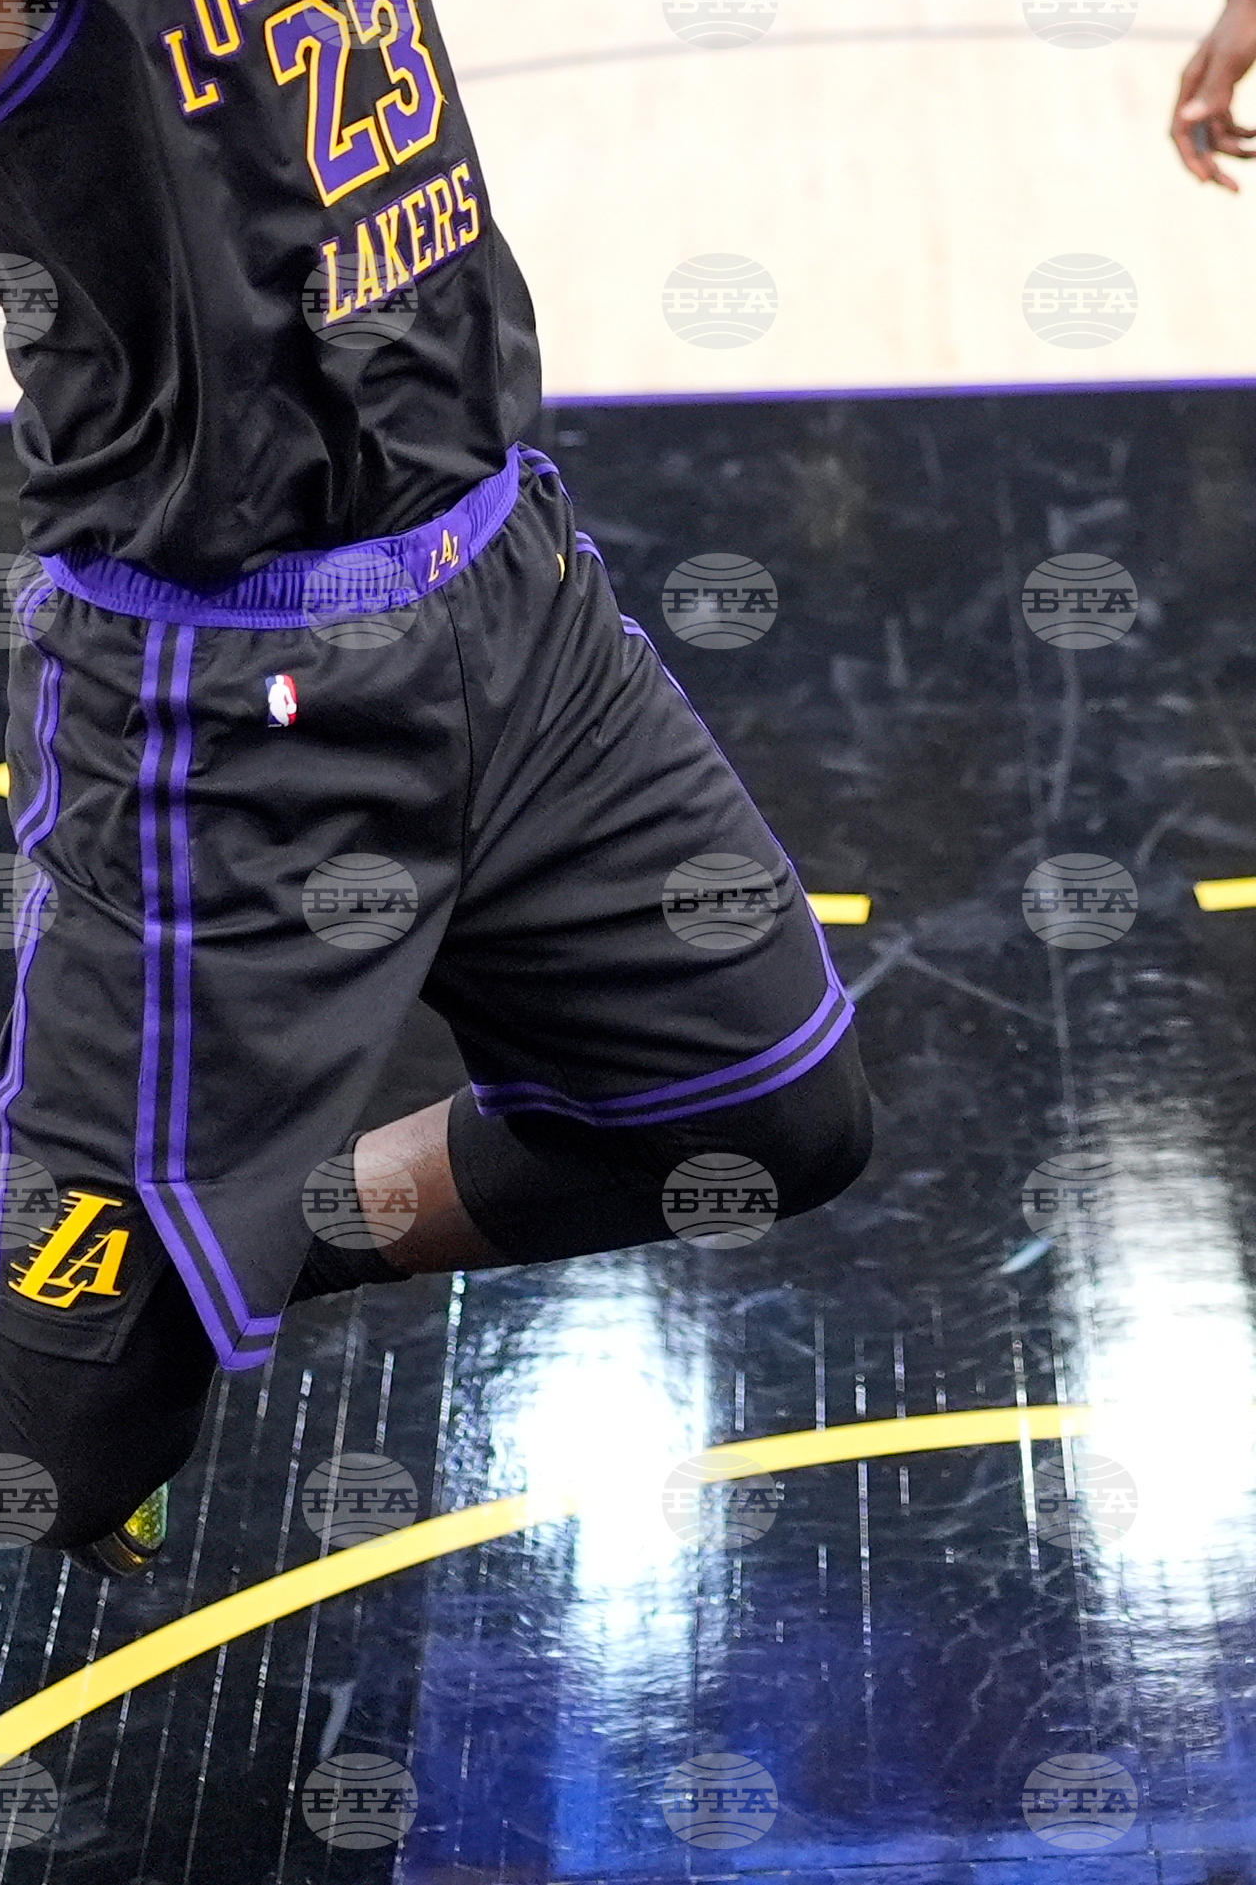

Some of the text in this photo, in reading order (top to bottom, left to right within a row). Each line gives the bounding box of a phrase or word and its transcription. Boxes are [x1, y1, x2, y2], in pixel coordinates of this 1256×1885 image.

[319, 159, 482, 327] LAKERS
[428, 529, 460, 583] LAL
[7, 1189, 130, 1309] LA
